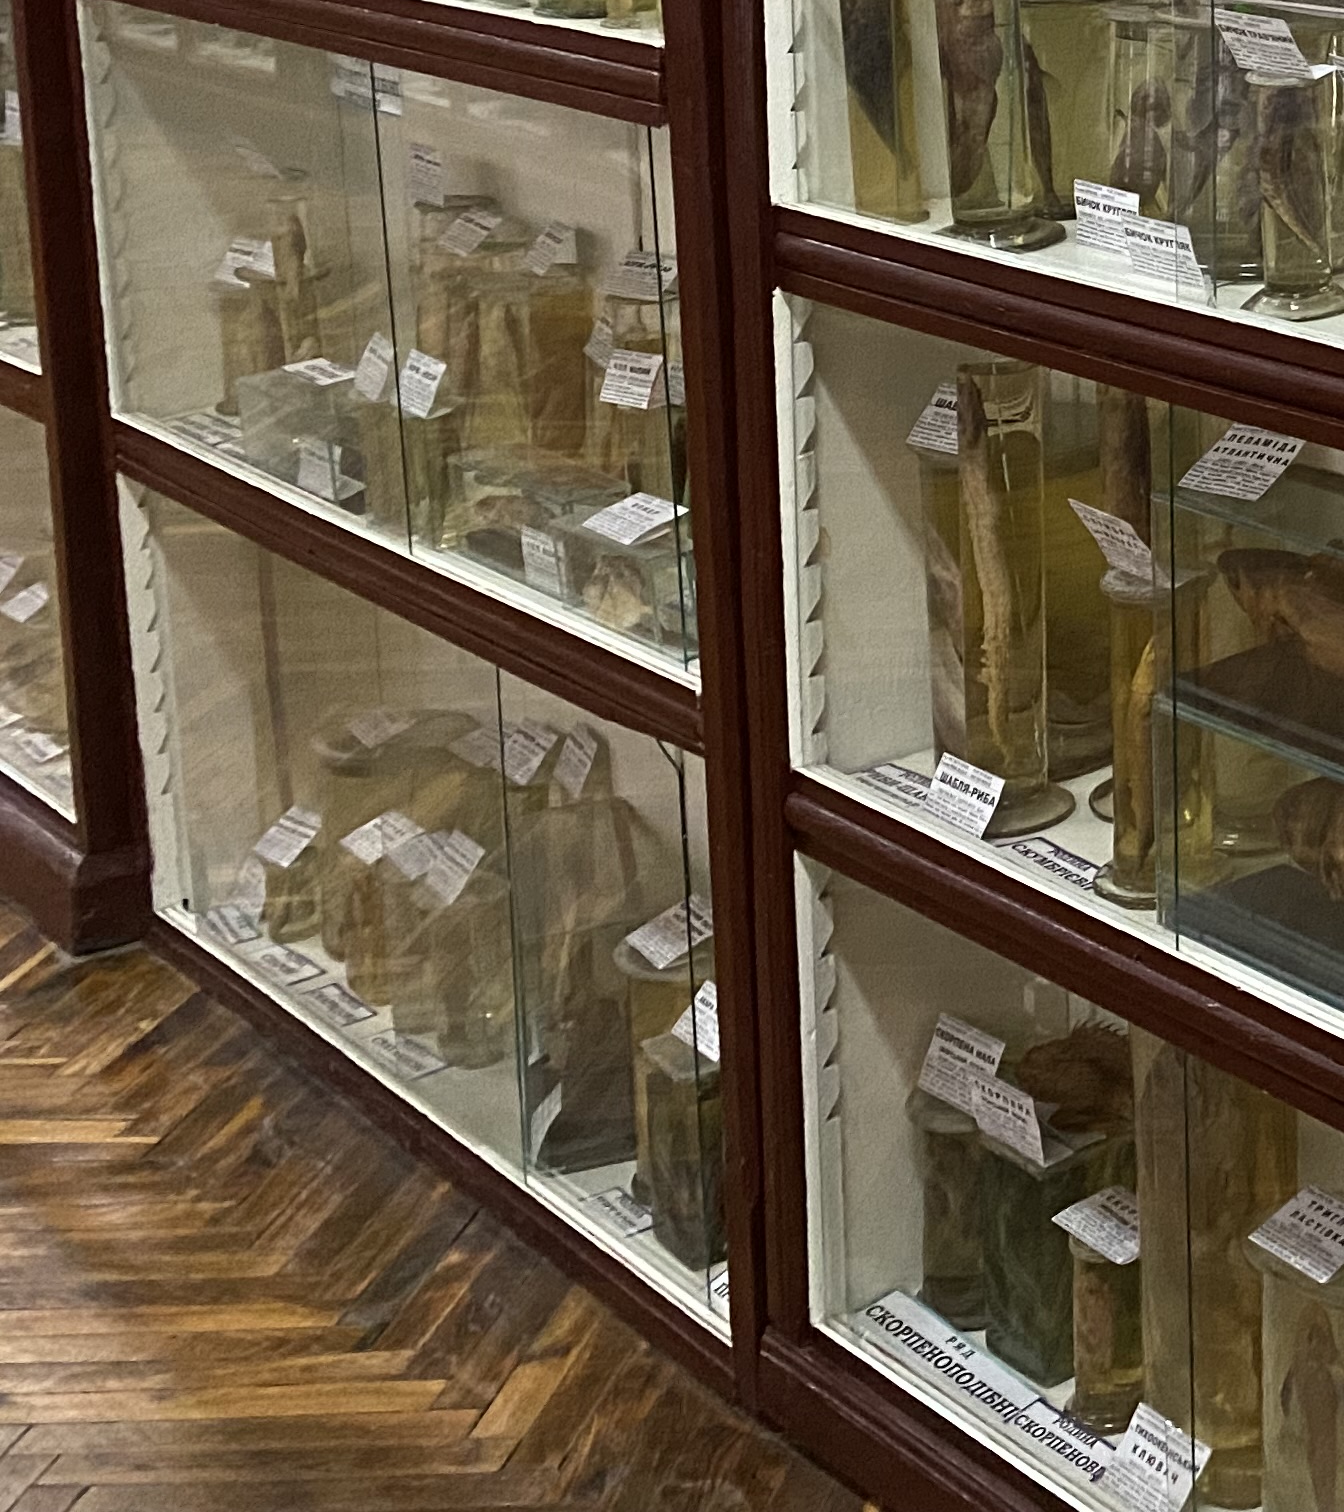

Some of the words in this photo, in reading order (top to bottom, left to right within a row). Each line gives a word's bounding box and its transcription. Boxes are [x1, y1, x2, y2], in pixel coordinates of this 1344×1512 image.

[1227, 433, 1298, 453] ПЕЛАМІДА
[1212, 446, 1290, 467] АТЛАНТИЧНА
[939, 771, 996, 807] ШАБЛЯ-РИБА
[945, 1336, 974, 1359] РЯД
[865, 1305, 1013, 1424] СКОРПЕНОПОДІБНІ
